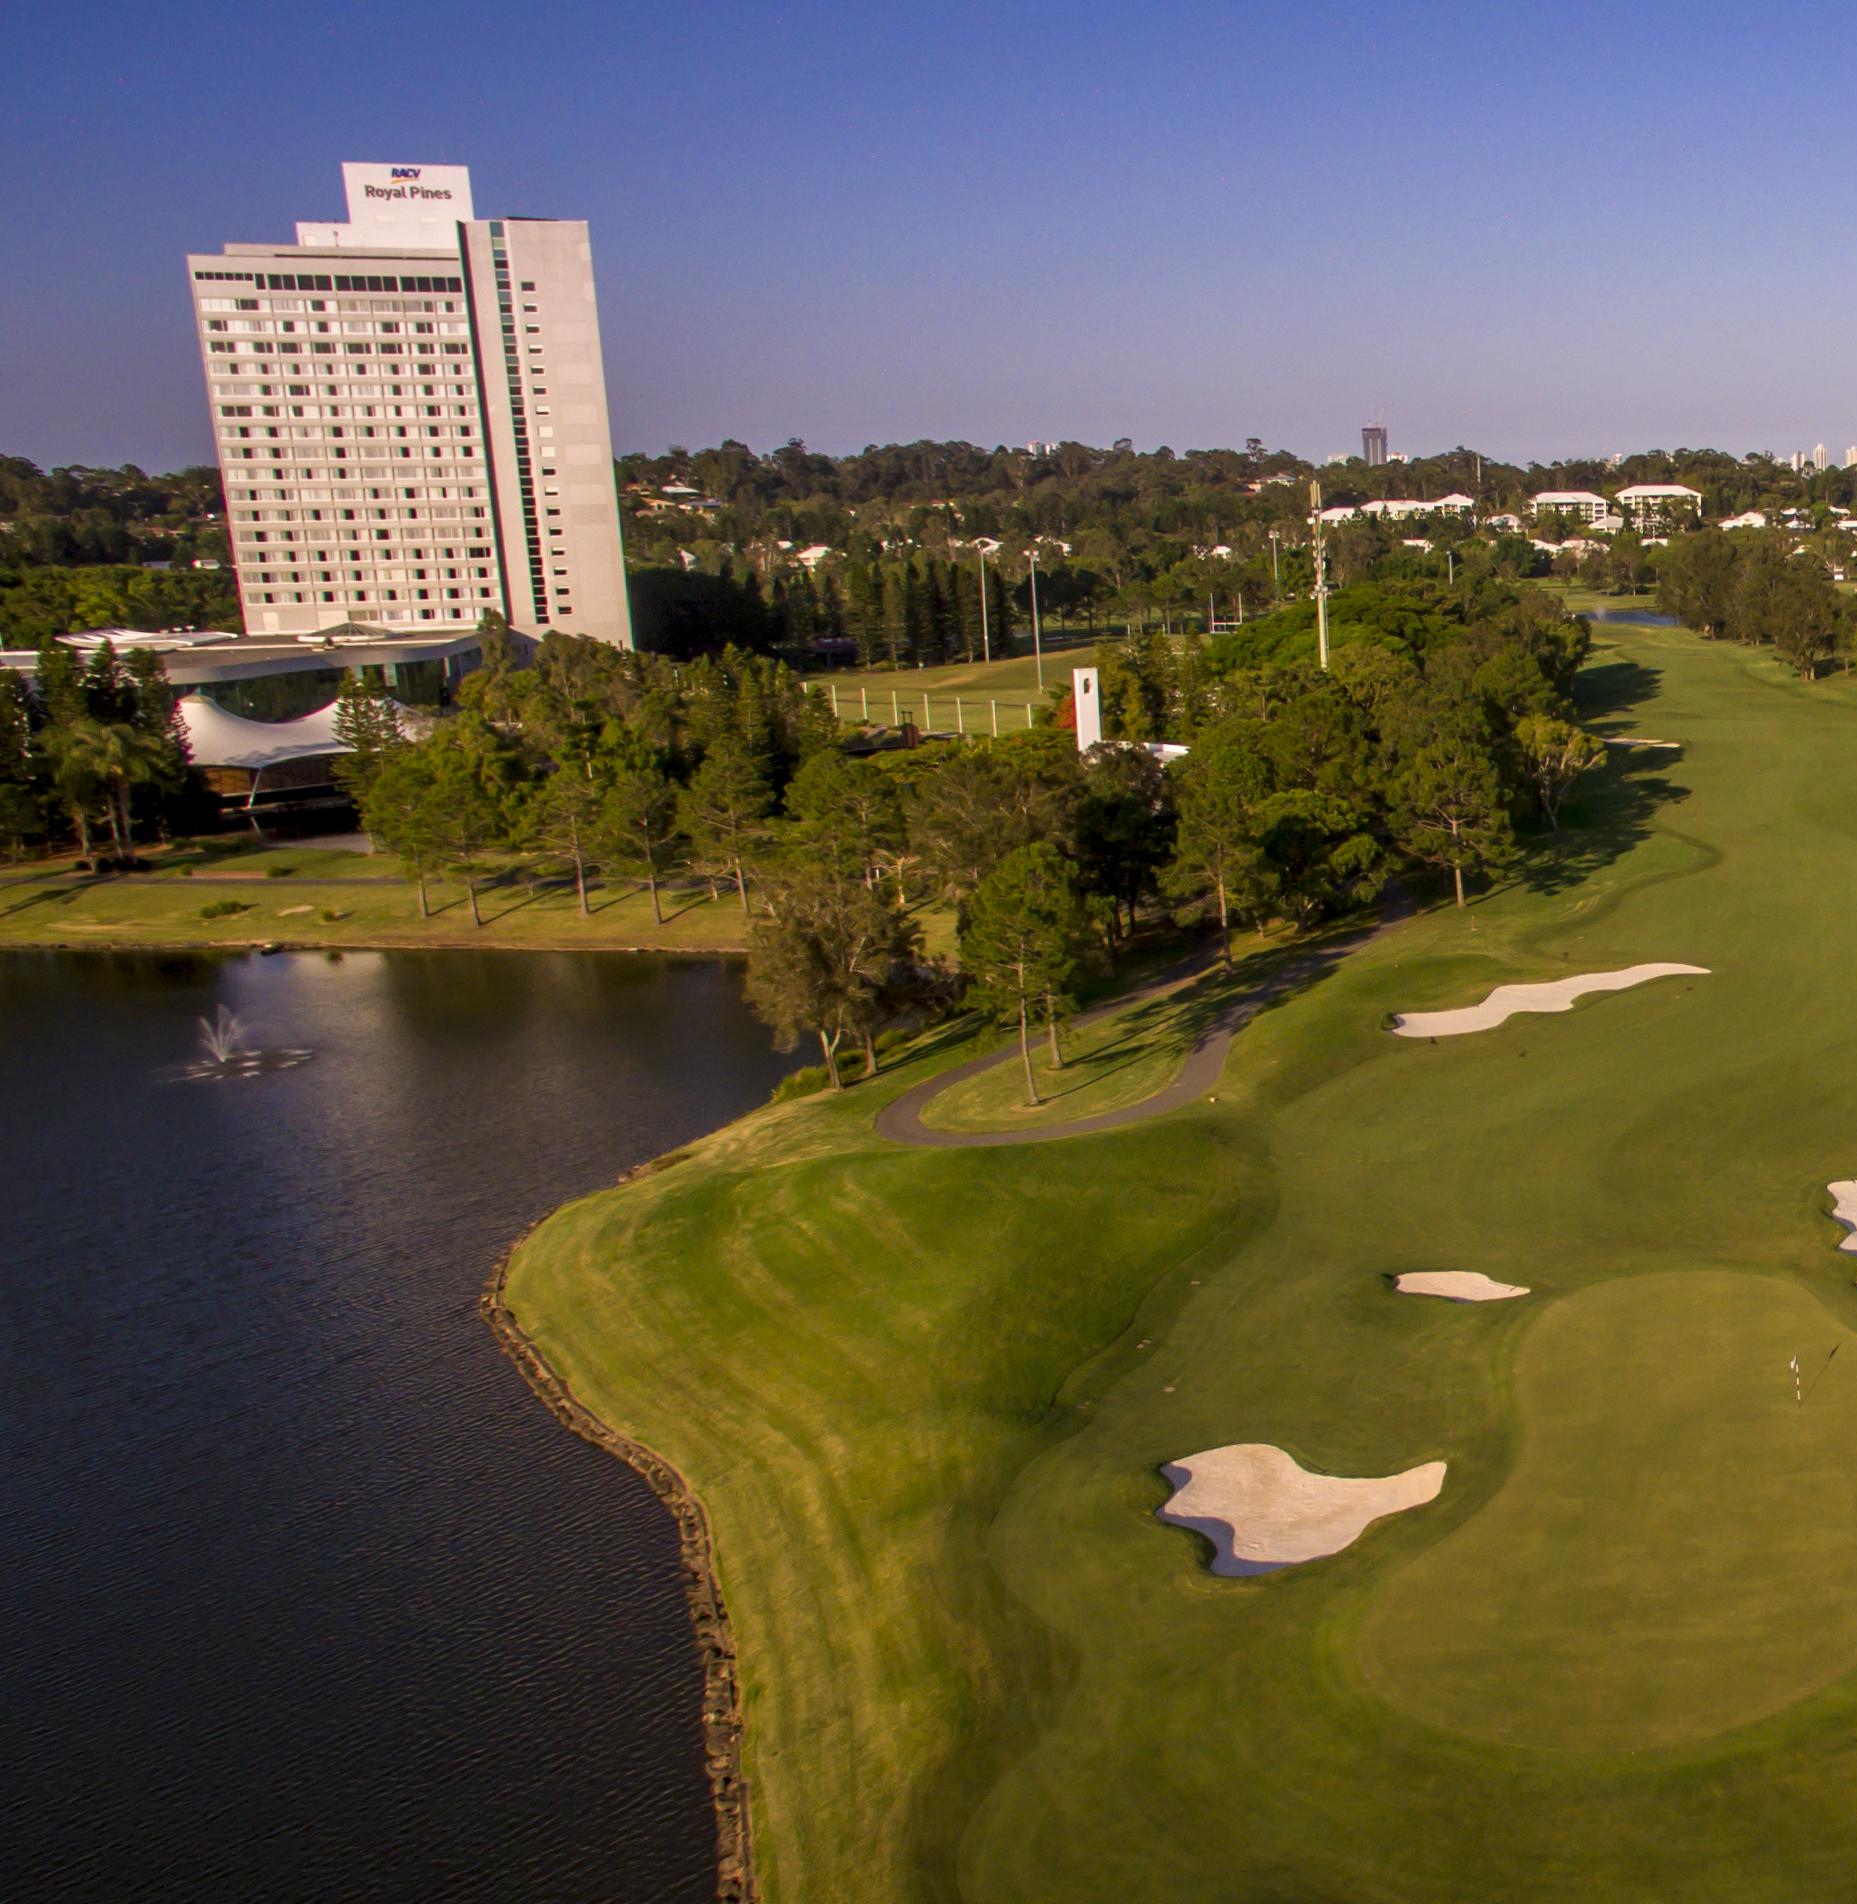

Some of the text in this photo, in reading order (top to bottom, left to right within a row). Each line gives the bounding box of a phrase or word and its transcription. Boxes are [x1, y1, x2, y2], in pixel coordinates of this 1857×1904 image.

[391, 168, 421, 178] RACV
[365, 185, 452, 201] Royal Pines
